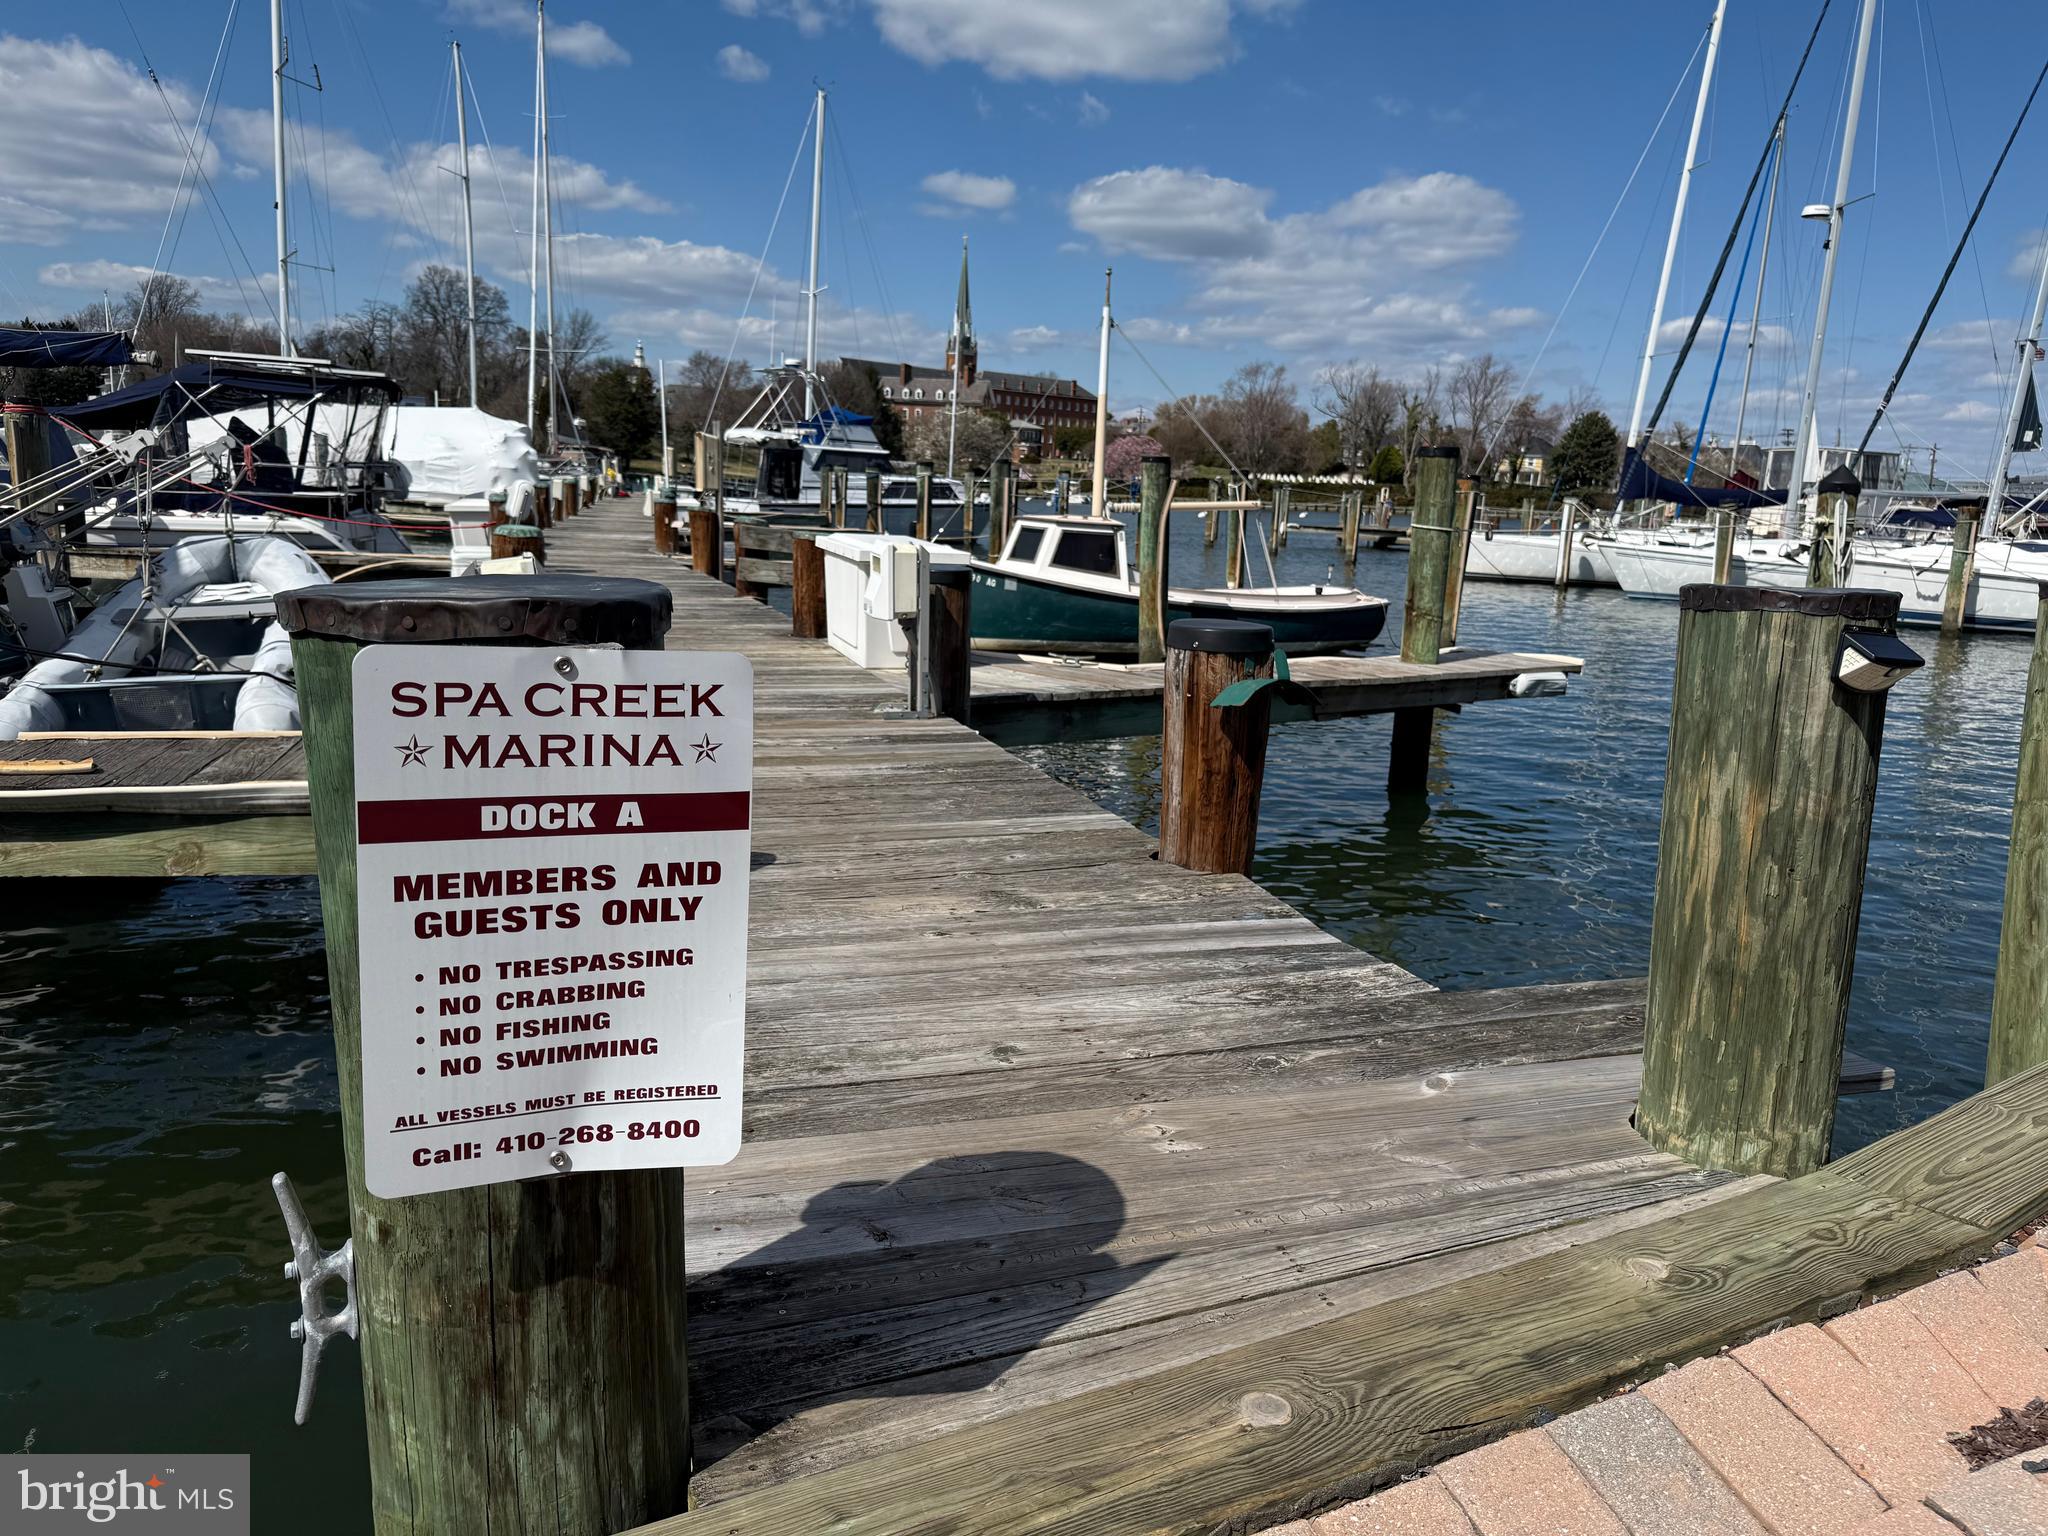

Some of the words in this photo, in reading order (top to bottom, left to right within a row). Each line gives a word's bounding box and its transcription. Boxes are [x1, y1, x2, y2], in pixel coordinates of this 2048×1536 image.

[391, 682, 513, 718] SPA
[524, 683, 726, 719] CREEK
[443, 733, 684, 770] MARINA
[481, 802, 596, 832] DOCK
[615, 801, 645, 827] A
[393, 864, 617, 903] MEMBERS
[636, 860, 722, 889] AND
[414, 902, 581, 940] GUESTS
[601, 896, 704, 926] ONLY
[438, 964, 481, 986] NO
[495, 948, 694, 980] TRESPASSING
[439, 994, 481, 1017] NO
[495, 980, 646, 1011] CRABBING
[439, 1025, 482, 1047] NO
[496, 1011, 611, 1041] FISHING
[440, 1055, 482, 1078] NO
[496, 1037, 658, 1071] SWIMMING
[394, 1113, 429, 1129] ALL
[436, 1102, 517, 1123] VESSELS
[525, 1094, 576, 1112] MUST
[583, 1091, 606, 1103] BE
[614, 1084, 718, 1101] REGISTERED
[412, 1141, 482, 1167] Call:
[495, 1119, 700, 1155] 410-268-8400
